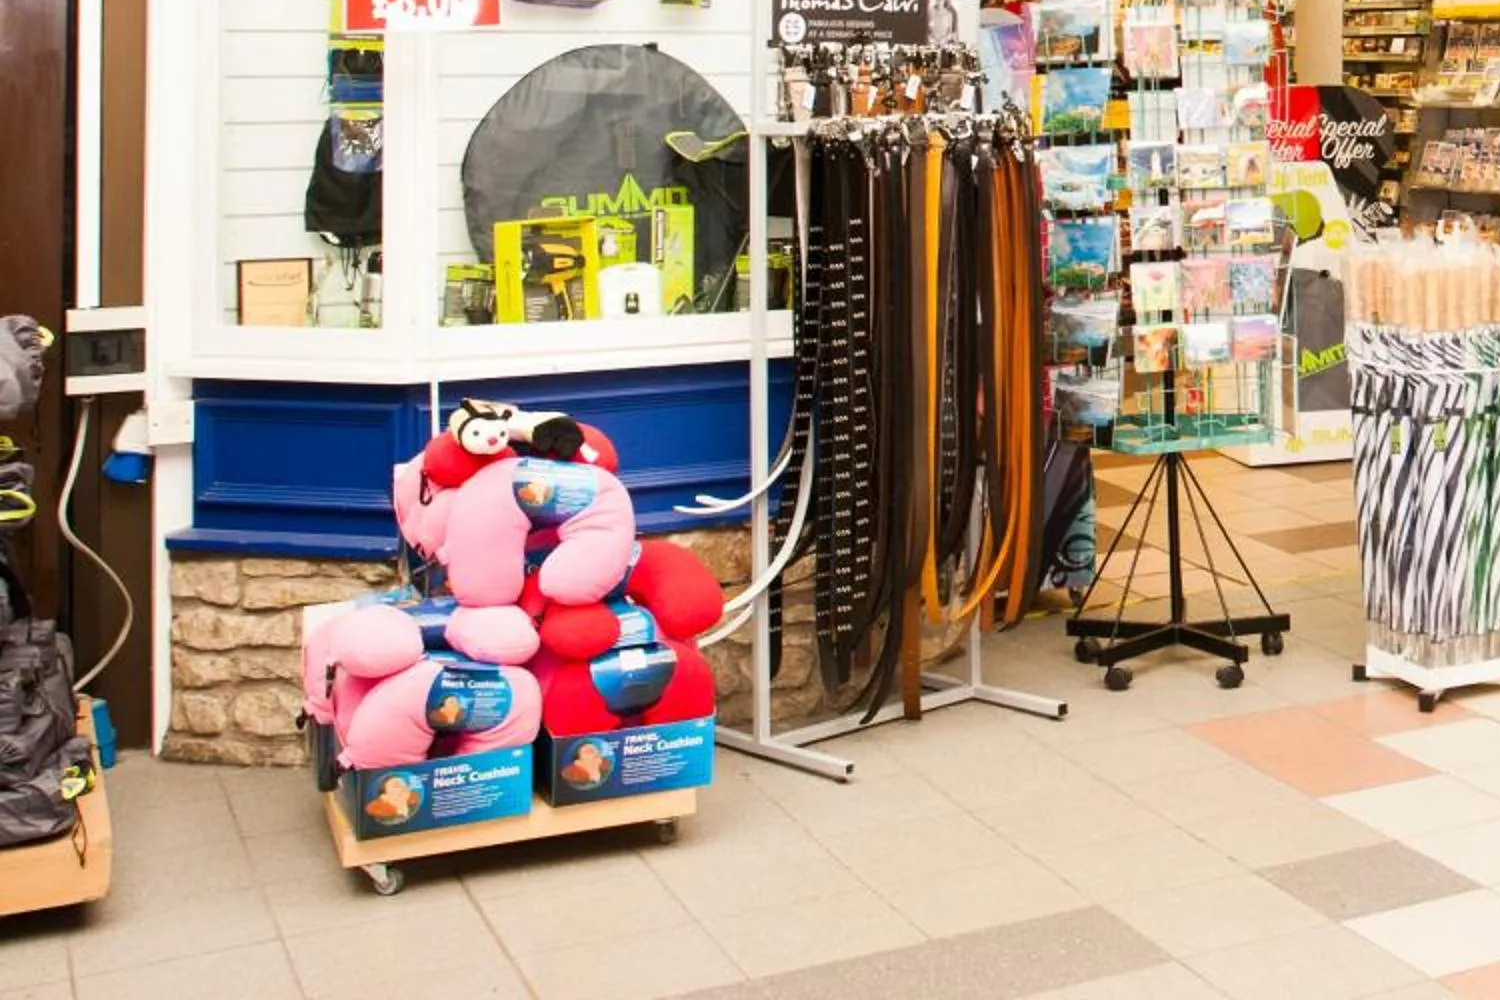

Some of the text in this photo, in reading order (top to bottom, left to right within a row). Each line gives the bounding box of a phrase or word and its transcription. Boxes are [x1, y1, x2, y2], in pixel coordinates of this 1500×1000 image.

[1318, 113, 1387, 142] Special
[1321, 134, 1375, 169] Offer
[623, 742, 653, 756] Neck
[657, 735, 704, 751] Cushion
[433, 775, 466, 788] Neck
[469, 765, 521, 782] Cushion
